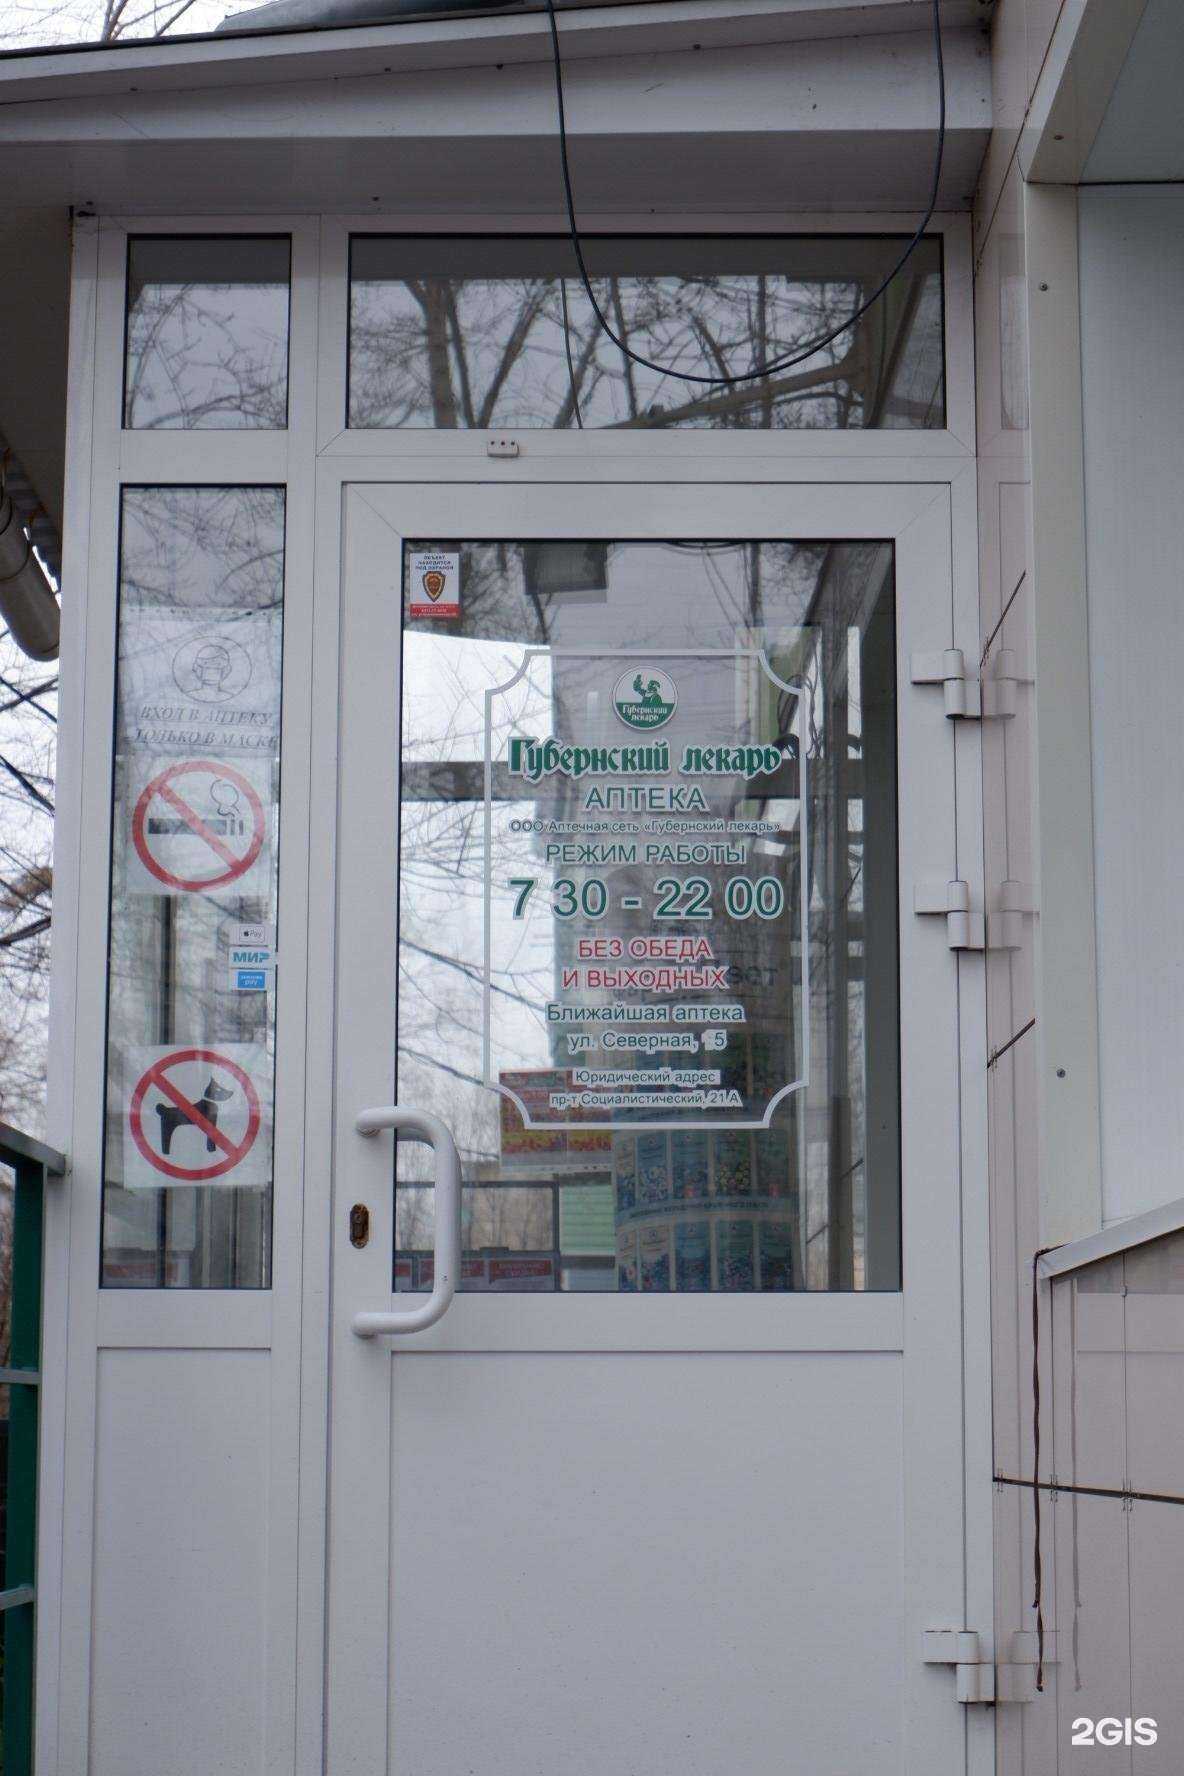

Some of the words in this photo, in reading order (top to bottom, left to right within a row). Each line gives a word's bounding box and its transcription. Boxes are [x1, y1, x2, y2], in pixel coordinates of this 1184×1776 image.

[140, 706, 182, 721] ВХОД
[188, 708, 199, 720] В
[134, 727, 201, 744] ТОЛЬКО
[203, 732, 216, 744] В
[509, 737, 671, 782] Губернский
[681, 744, 783, 780] лекарь
[585, 787, 707, 809] АПТЕКА
[510, 820, 543, 832] ООО
[548, 820, 608, 832] Аптечная
[611, 822, 639, 832] сеть
[644, 819, 725, 834] «Губернский
[729, 821, 781, 834] лекарь»
[546, 844, 636, 863] РЕЖИМ
[645, 844, 746, 863] РАБОТЫ
[509, 879, 536, 919] 7
[553, 879, 608, 918] 30
[656, 879, 711, 918] 22
[727, 879, 784, 918] 00
[232, 951, 270, 963] МИР
[578, 940, 622, 958] БЕЗ
[630, 940, 712, 962] ОБЕДА
[562, 969, 579, 988] И
[587, 969, 728, 991] ВЫХОДНЫХ
[547, 1003, 667, 1021] Ближайшая
[675, 1007, 743, 1021] аптека
[568, 1034, 595, 1052] ул.
[602, 1032, 698, 1052] Северная,
[575, 1070, 670, 1086] Юридический
[675, 1072, 716, 1086] адрес
[551, 1095, 577, 1107] пр-т
[581, 1093, 706, 1107] Социалистический,
